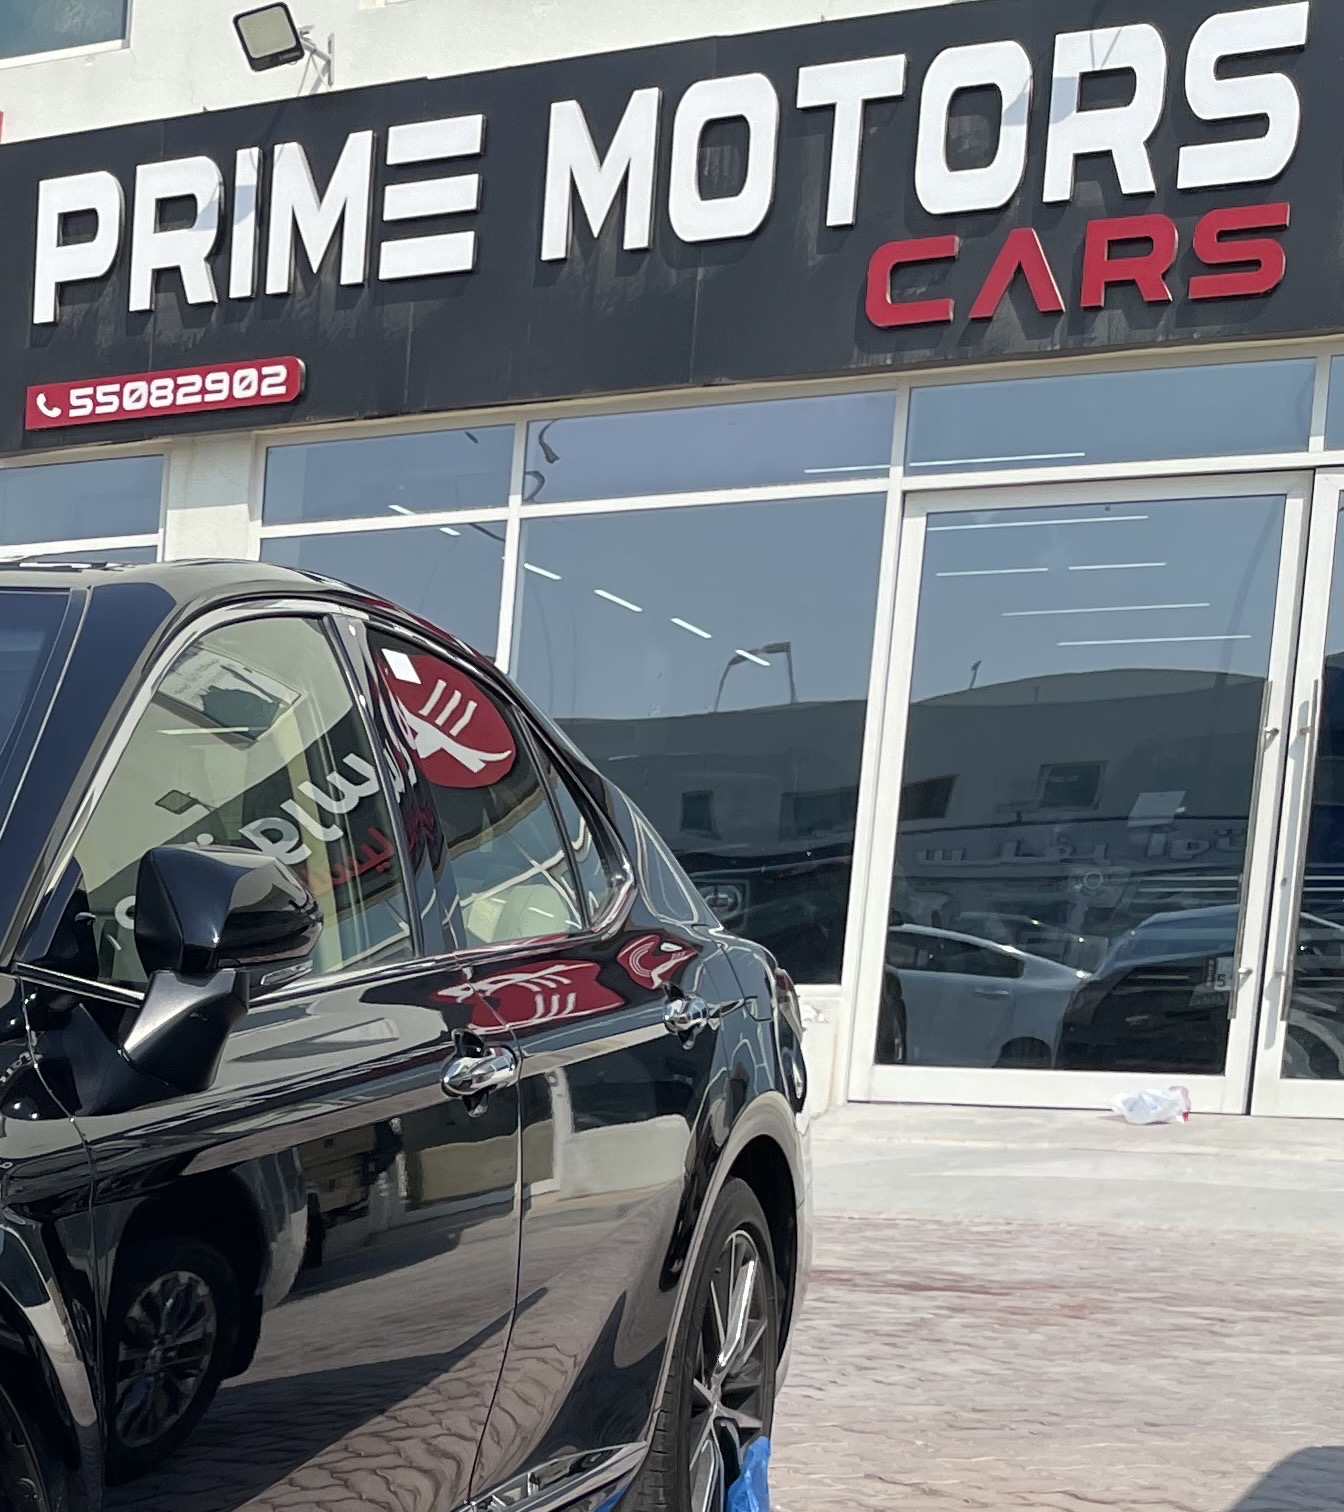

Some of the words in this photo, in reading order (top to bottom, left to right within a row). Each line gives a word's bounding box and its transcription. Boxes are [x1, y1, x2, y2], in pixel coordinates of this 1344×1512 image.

[33, 114, 486, 325] PRIME
[541, 1, 1312, 263] MOTORS
[864, 202, 1292, 329] CARS
[68, 364, 288, 418] 55082902
